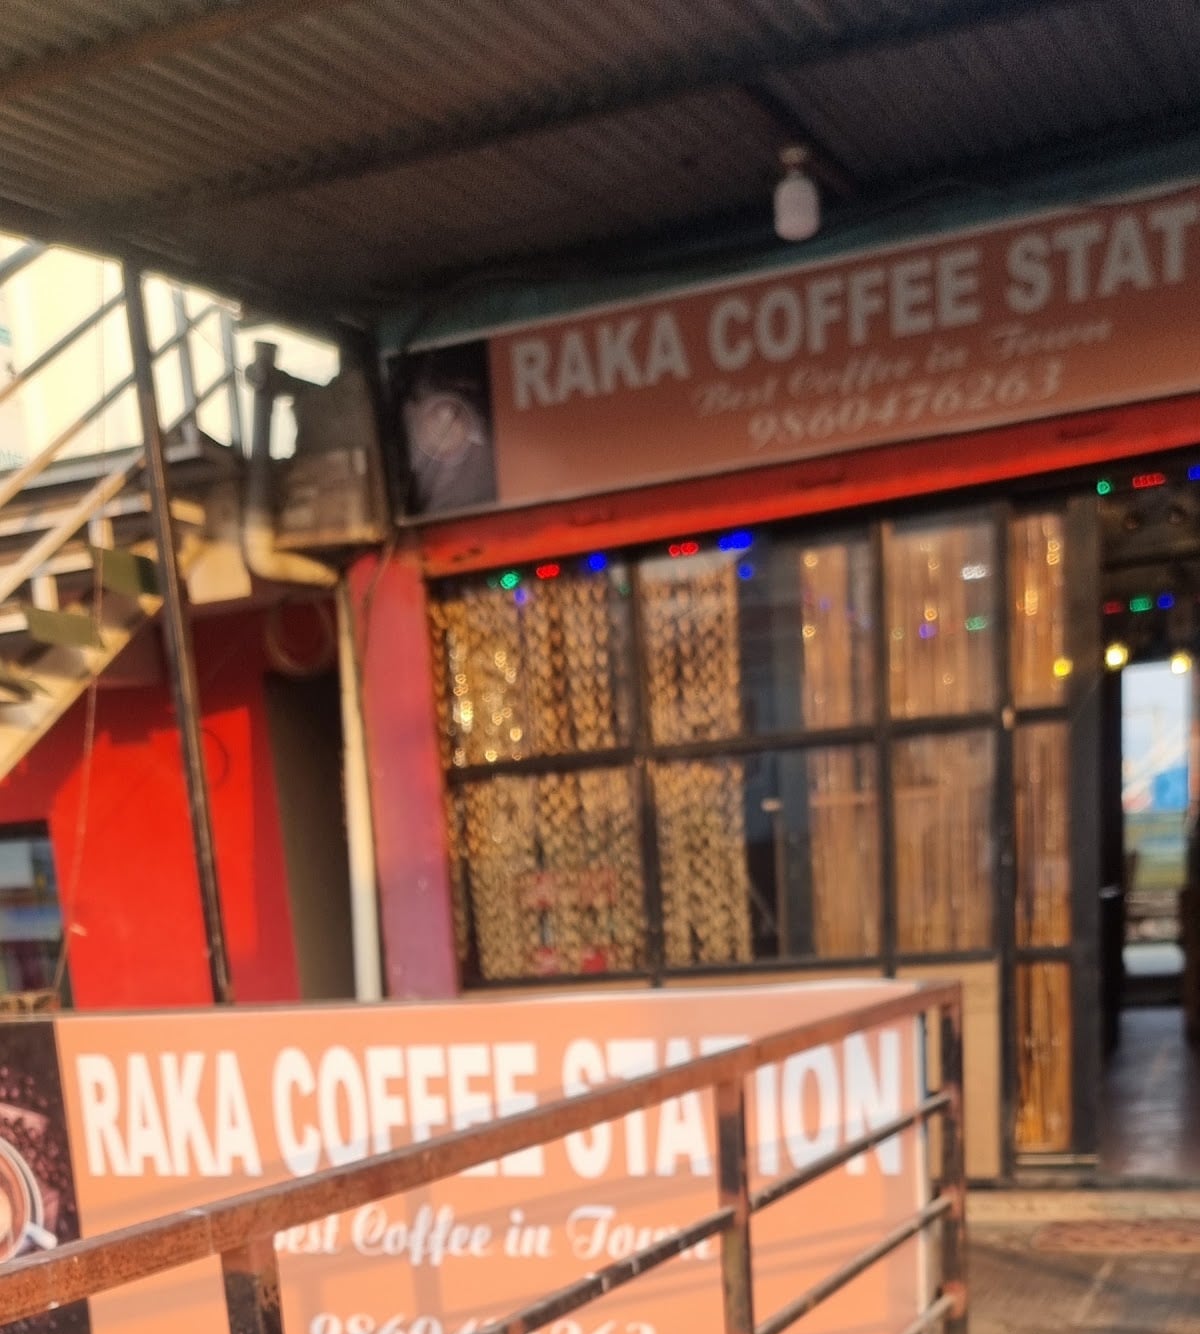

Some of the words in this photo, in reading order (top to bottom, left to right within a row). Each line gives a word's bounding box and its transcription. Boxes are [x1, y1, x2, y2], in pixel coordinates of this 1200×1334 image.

[511, 311, 691, 411] RAKA
[708, 247, 982, 372] COFFEE
[1006, 202, 1199, 315] STAT
[76, 1049, 263, 1178] RAKA
[272, 1042, 546, 1178] COFFEE
[562, 1028, 904, 1178] STAION
[273, 1212, 343, 1255] est
[351, 1202, 493, 1266] Coffee
[503, 1207, 552, 1258] in
